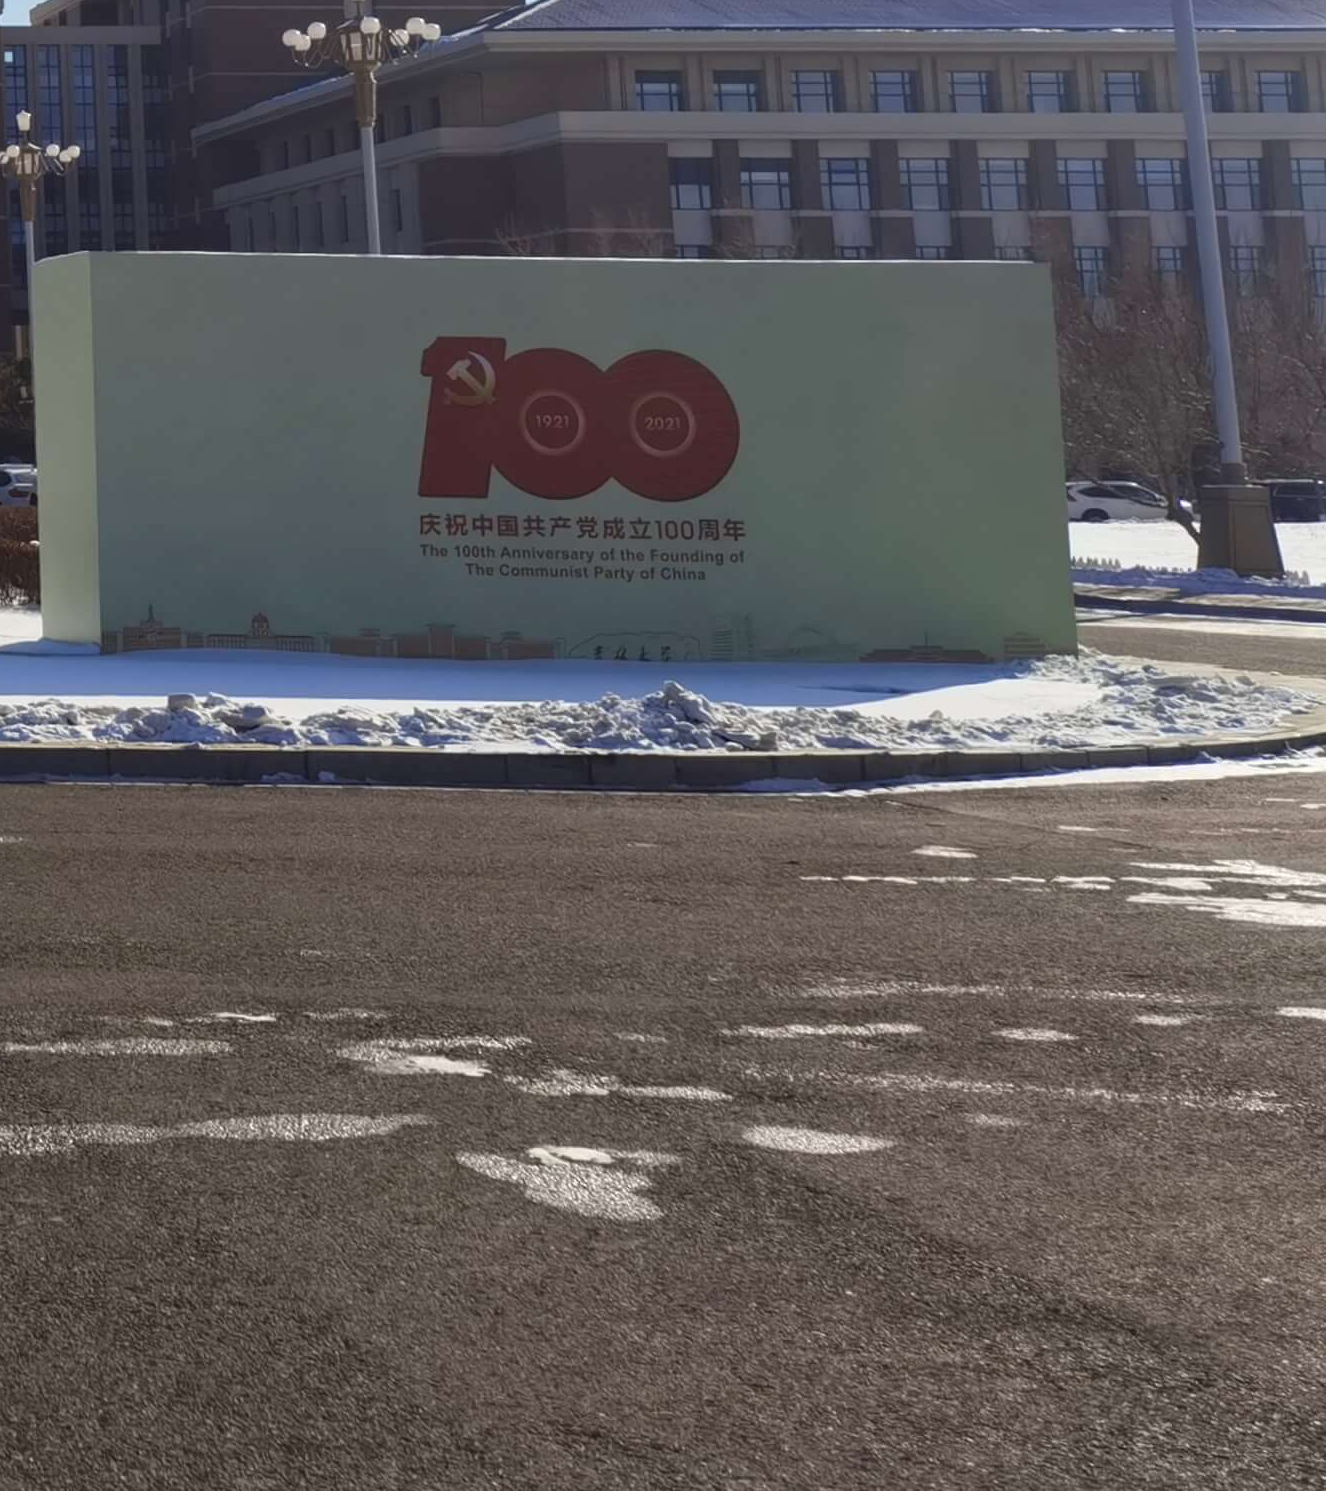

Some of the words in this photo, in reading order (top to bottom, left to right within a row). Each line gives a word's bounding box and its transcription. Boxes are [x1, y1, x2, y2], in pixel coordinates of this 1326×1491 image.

[418, 336, 741, 503] 100
[535, 414, 570, 429] 1921
[644, 416, 681, 431] 2021
[419, 514, 747, 541] 庆祝中国共产党成立100周年
[419, 544, 448, 557] The
[454, 545, 496, 559] 100th
[500, 546, 594, 563] Anniversary
[600, 548, 614, 561] of
[620, 548, 645, 561] the
[650, 549, 725, 565] Founding
[730, 550, 745, 564] of
[465, 563, 494, 577] The
[499, 564, 588, 579] Communist
[594, 566, 633, 582] Party
[640, 566, 655, 580] of
[660, 567, 707, 581] China
